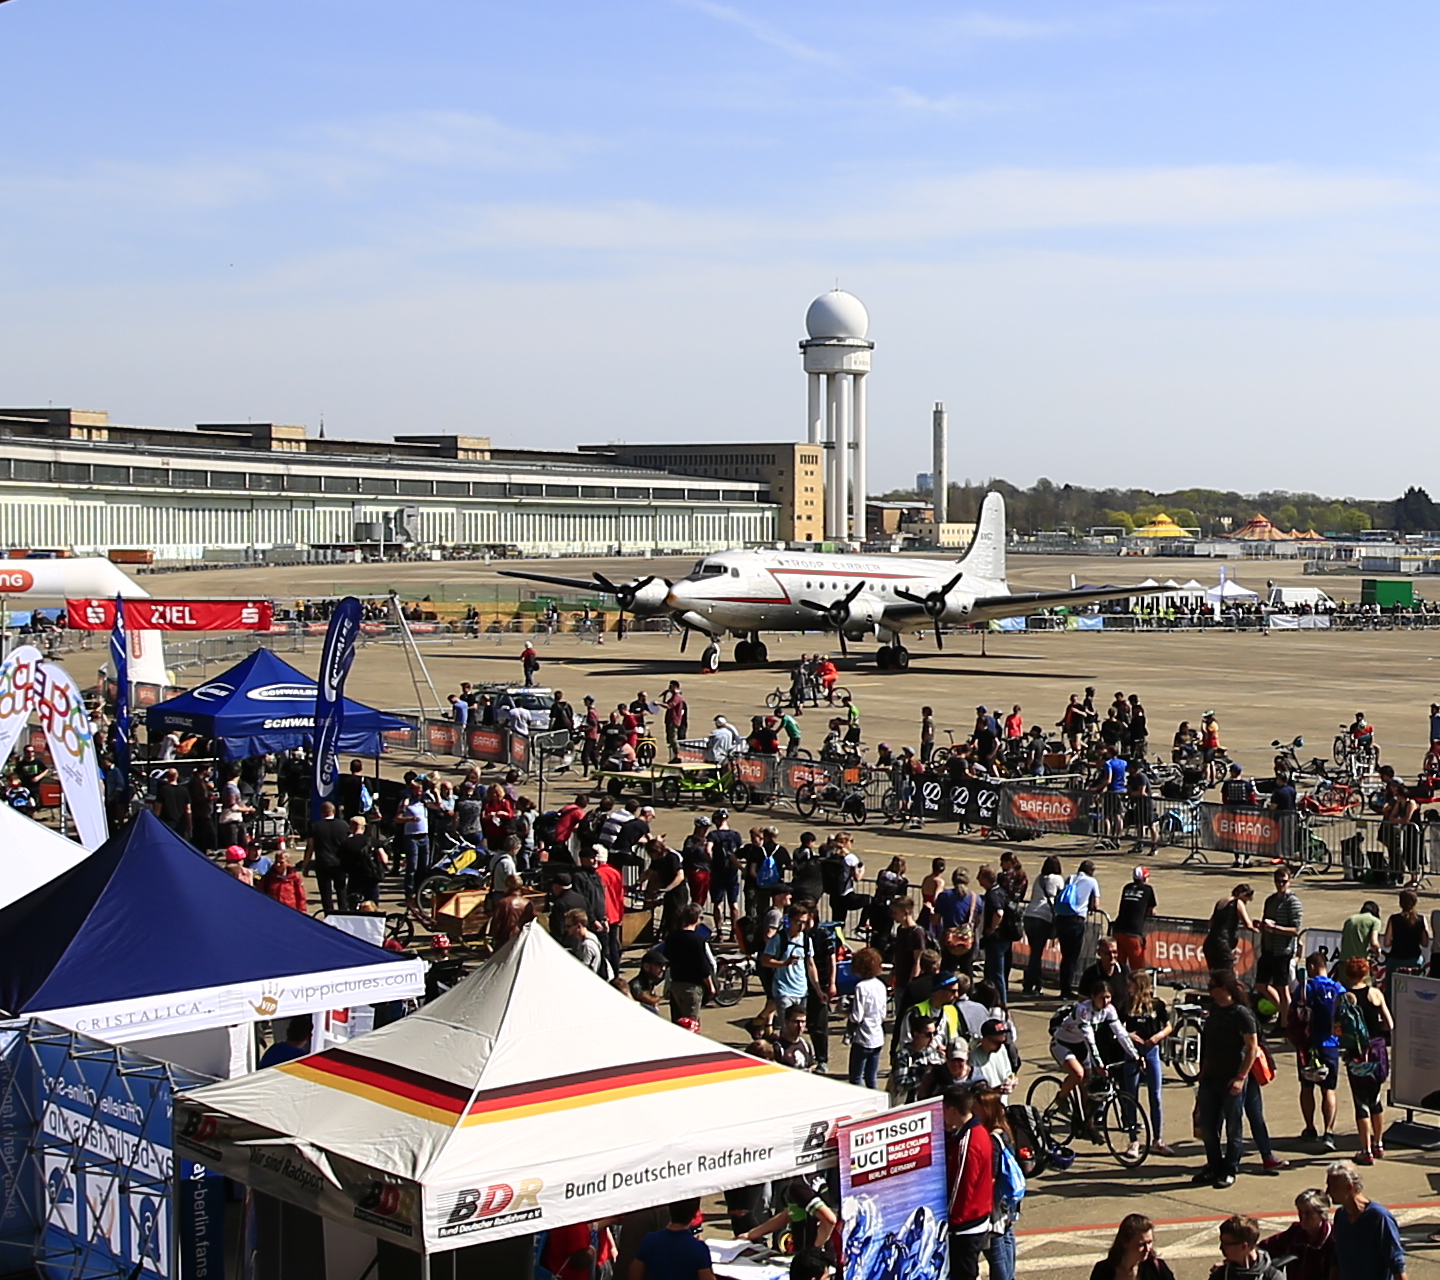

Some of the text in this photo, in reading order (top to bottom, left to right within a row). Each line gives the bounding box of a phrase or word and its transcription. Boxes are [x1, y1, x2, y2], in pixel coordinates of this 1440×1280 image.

[150, 605, 197, 625] ZIEL
[1019, 799, 1072, 816] BAFANG
[1220, 821, 1271, 838] BAFANG
[1155, 940, 1244, 964] BAFAG
[291, 972, 418, 1004] vip-pictures.com
[75, 1001, 202, 1032] CRISTALICA
[261, 997, 277, 1012] VIP
[875, 1117, 927, 1141] TISSOT
[250, 1146, 325, 1192] Wir sind Radsport
[857, 1149, 884, 1168] UCI
[869, 1161, 917, 1180] BERLIN GERMANY
[565, 1146, 775, 1200] Bund Deutscher Radfahrer
[440, 1178, 544, 1222] BDR
